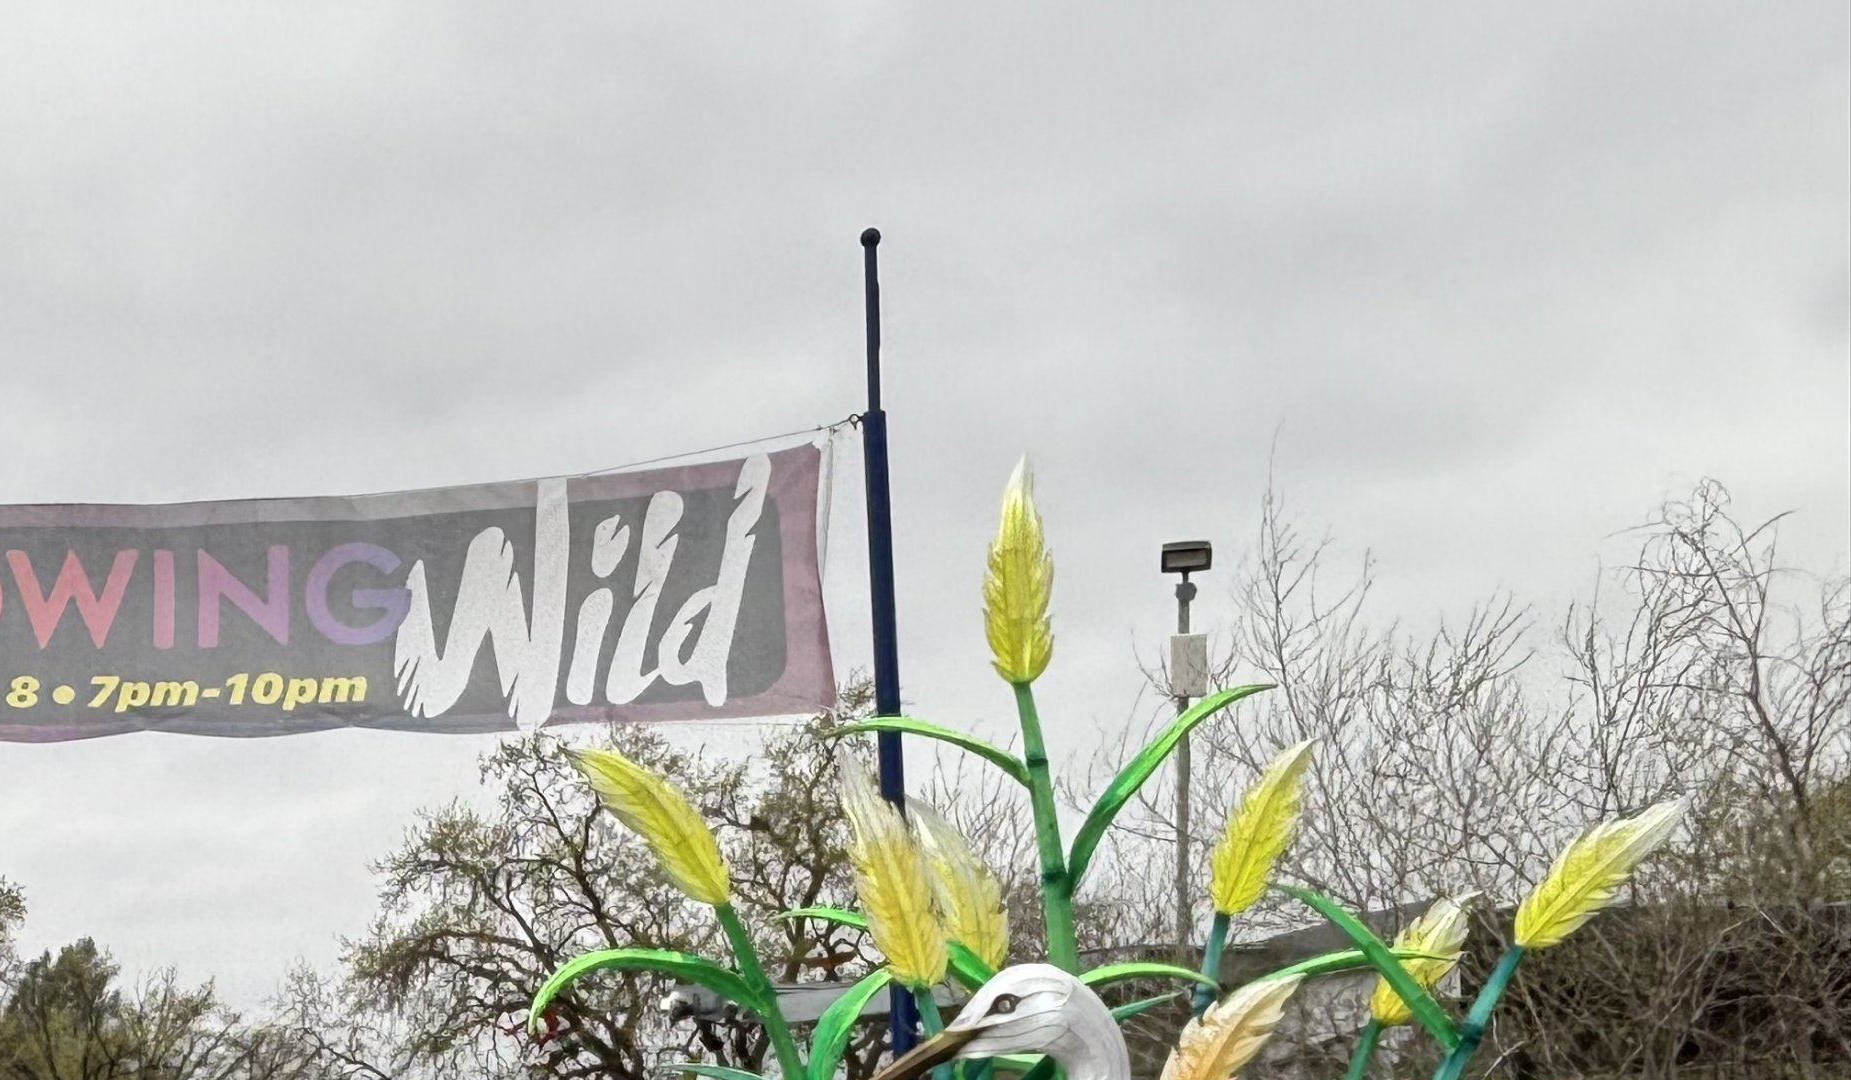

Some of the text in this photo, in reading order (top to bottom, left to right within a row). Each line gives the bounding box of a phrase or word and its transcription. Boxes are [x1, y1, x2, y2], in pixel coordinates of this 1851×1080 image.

[394, 452, 771, 731] Wild
[5, 675, 40, 708] 8
[87, 672, 368, 712] 7pm-10pm
